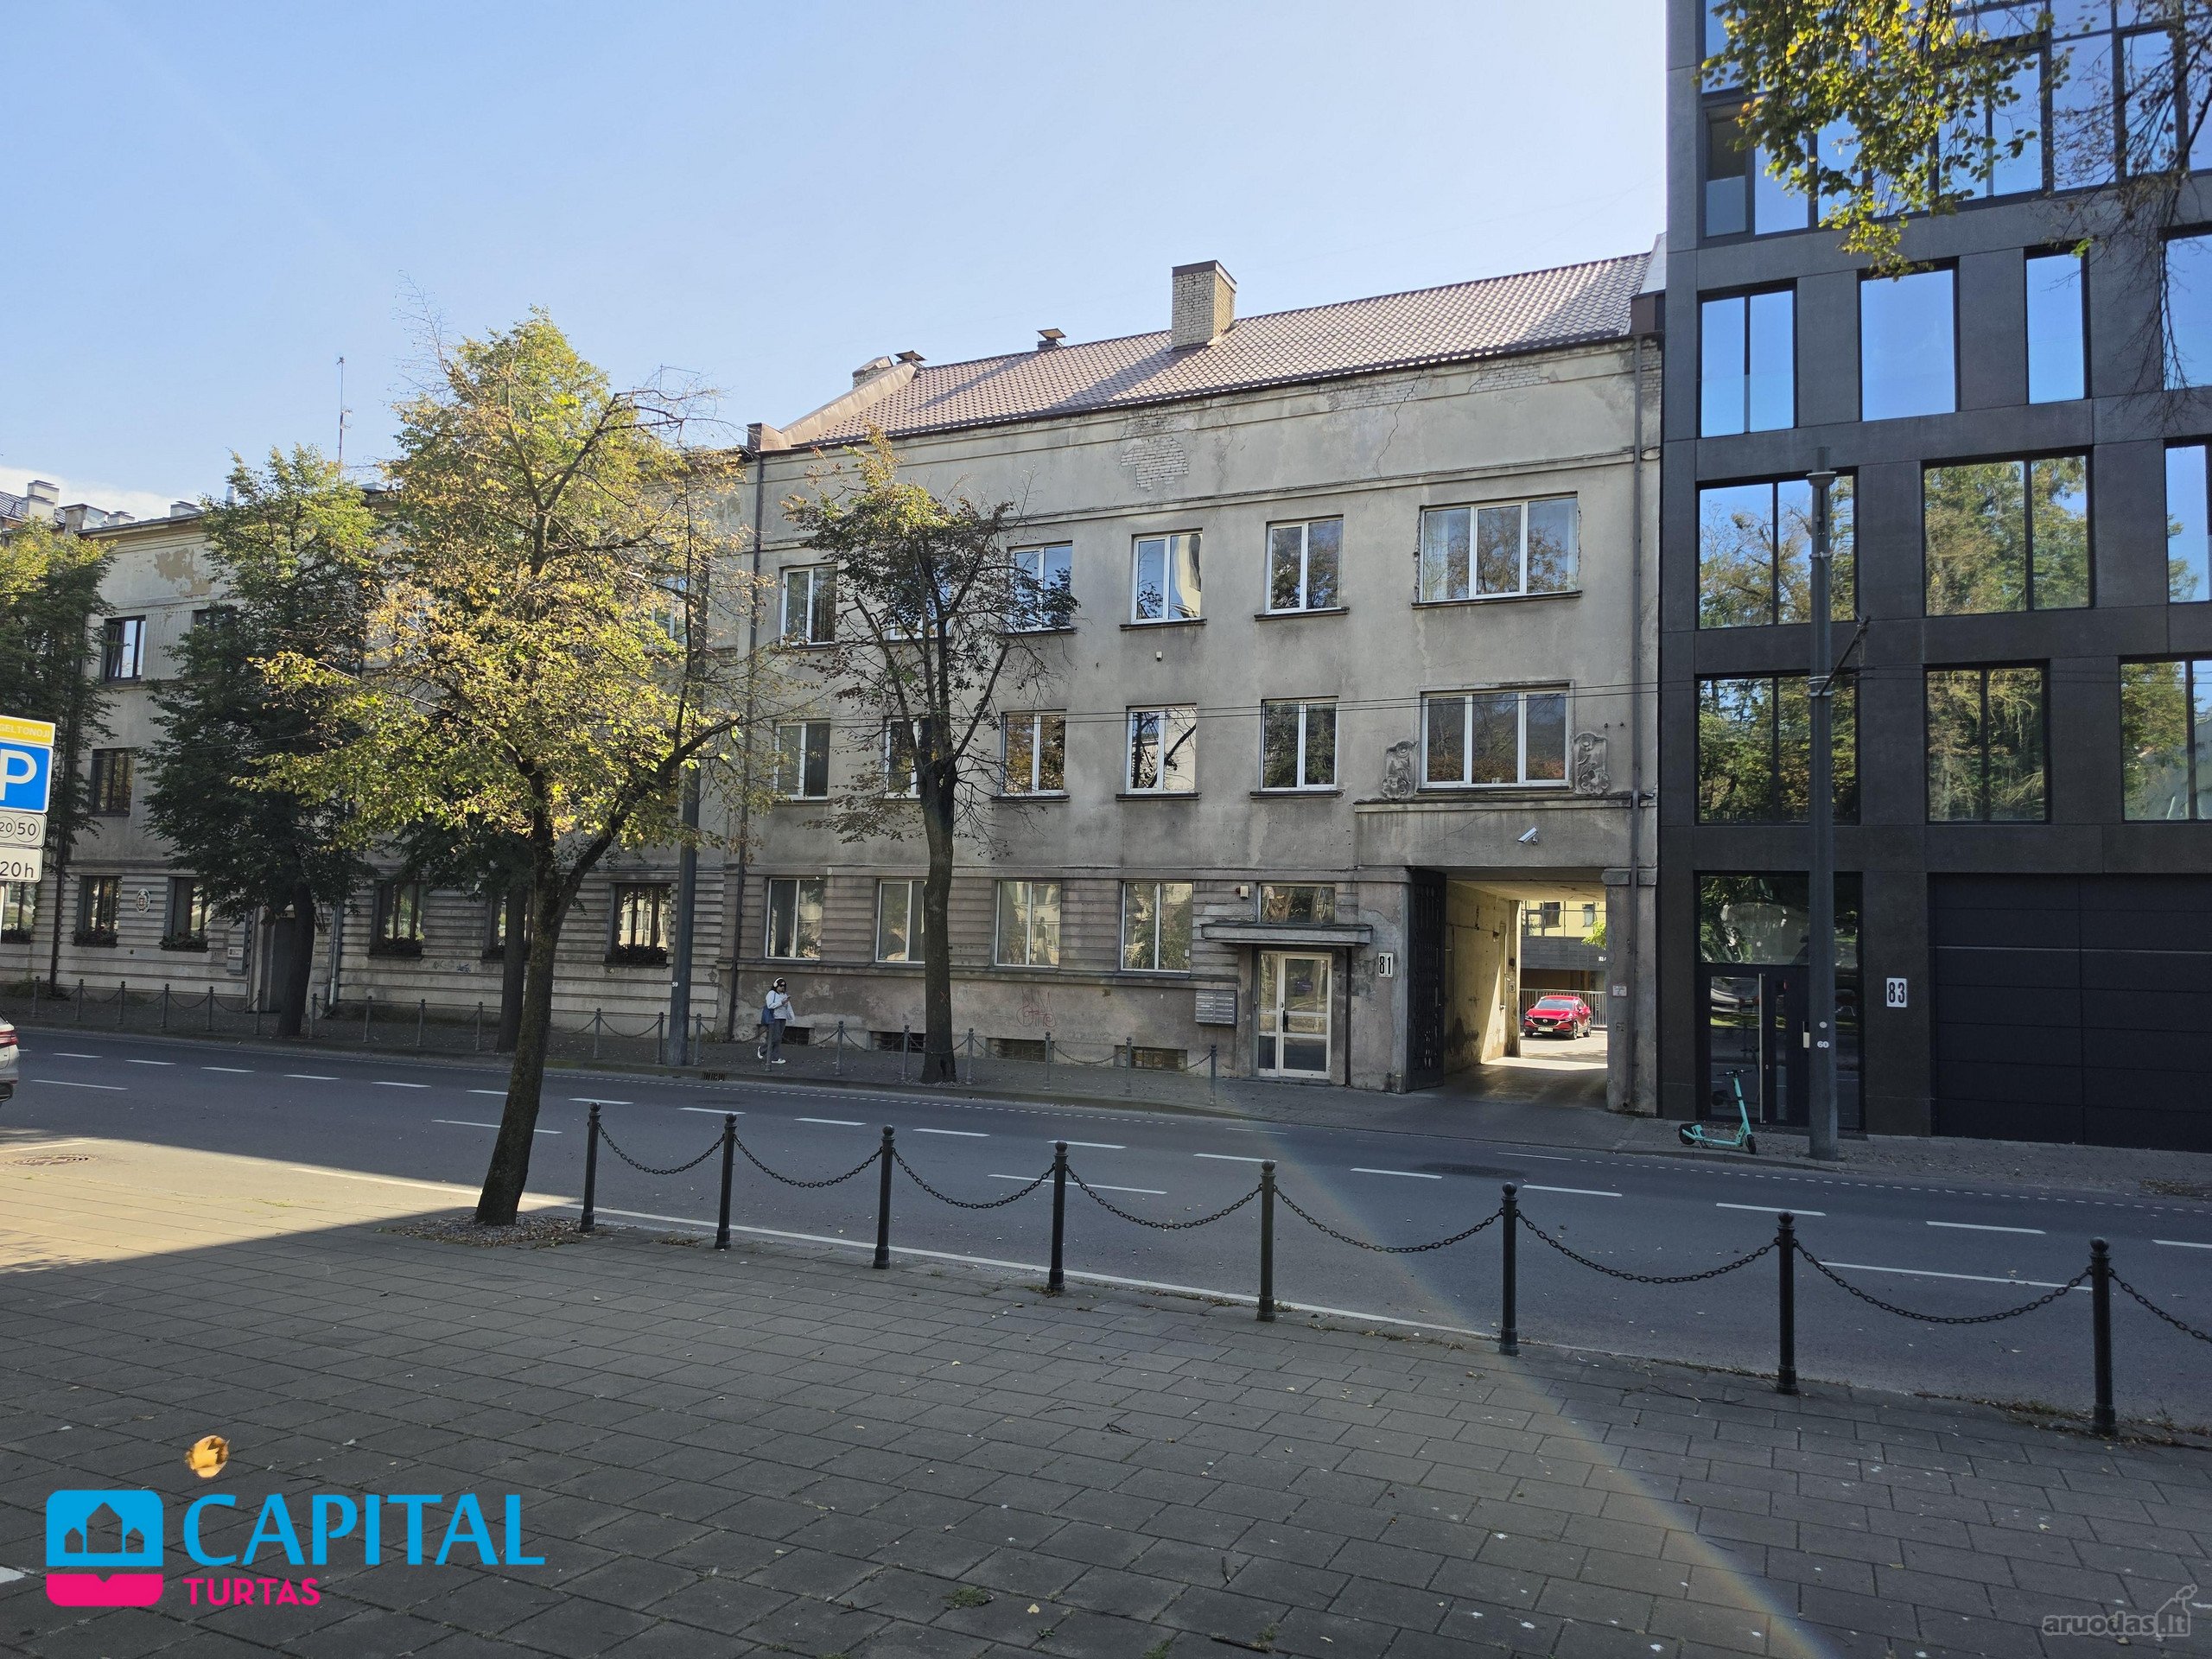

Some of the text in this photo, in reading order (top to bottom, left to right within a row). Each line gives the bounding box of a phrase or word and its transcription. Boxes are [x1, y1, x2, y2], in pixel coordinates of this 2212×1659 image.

[0, 748, 37, 800] P
[17, 823, 36, 836] 50
[1379, 956, 1391, 974] 81
[1888, 982, 1905, 1003] 83
